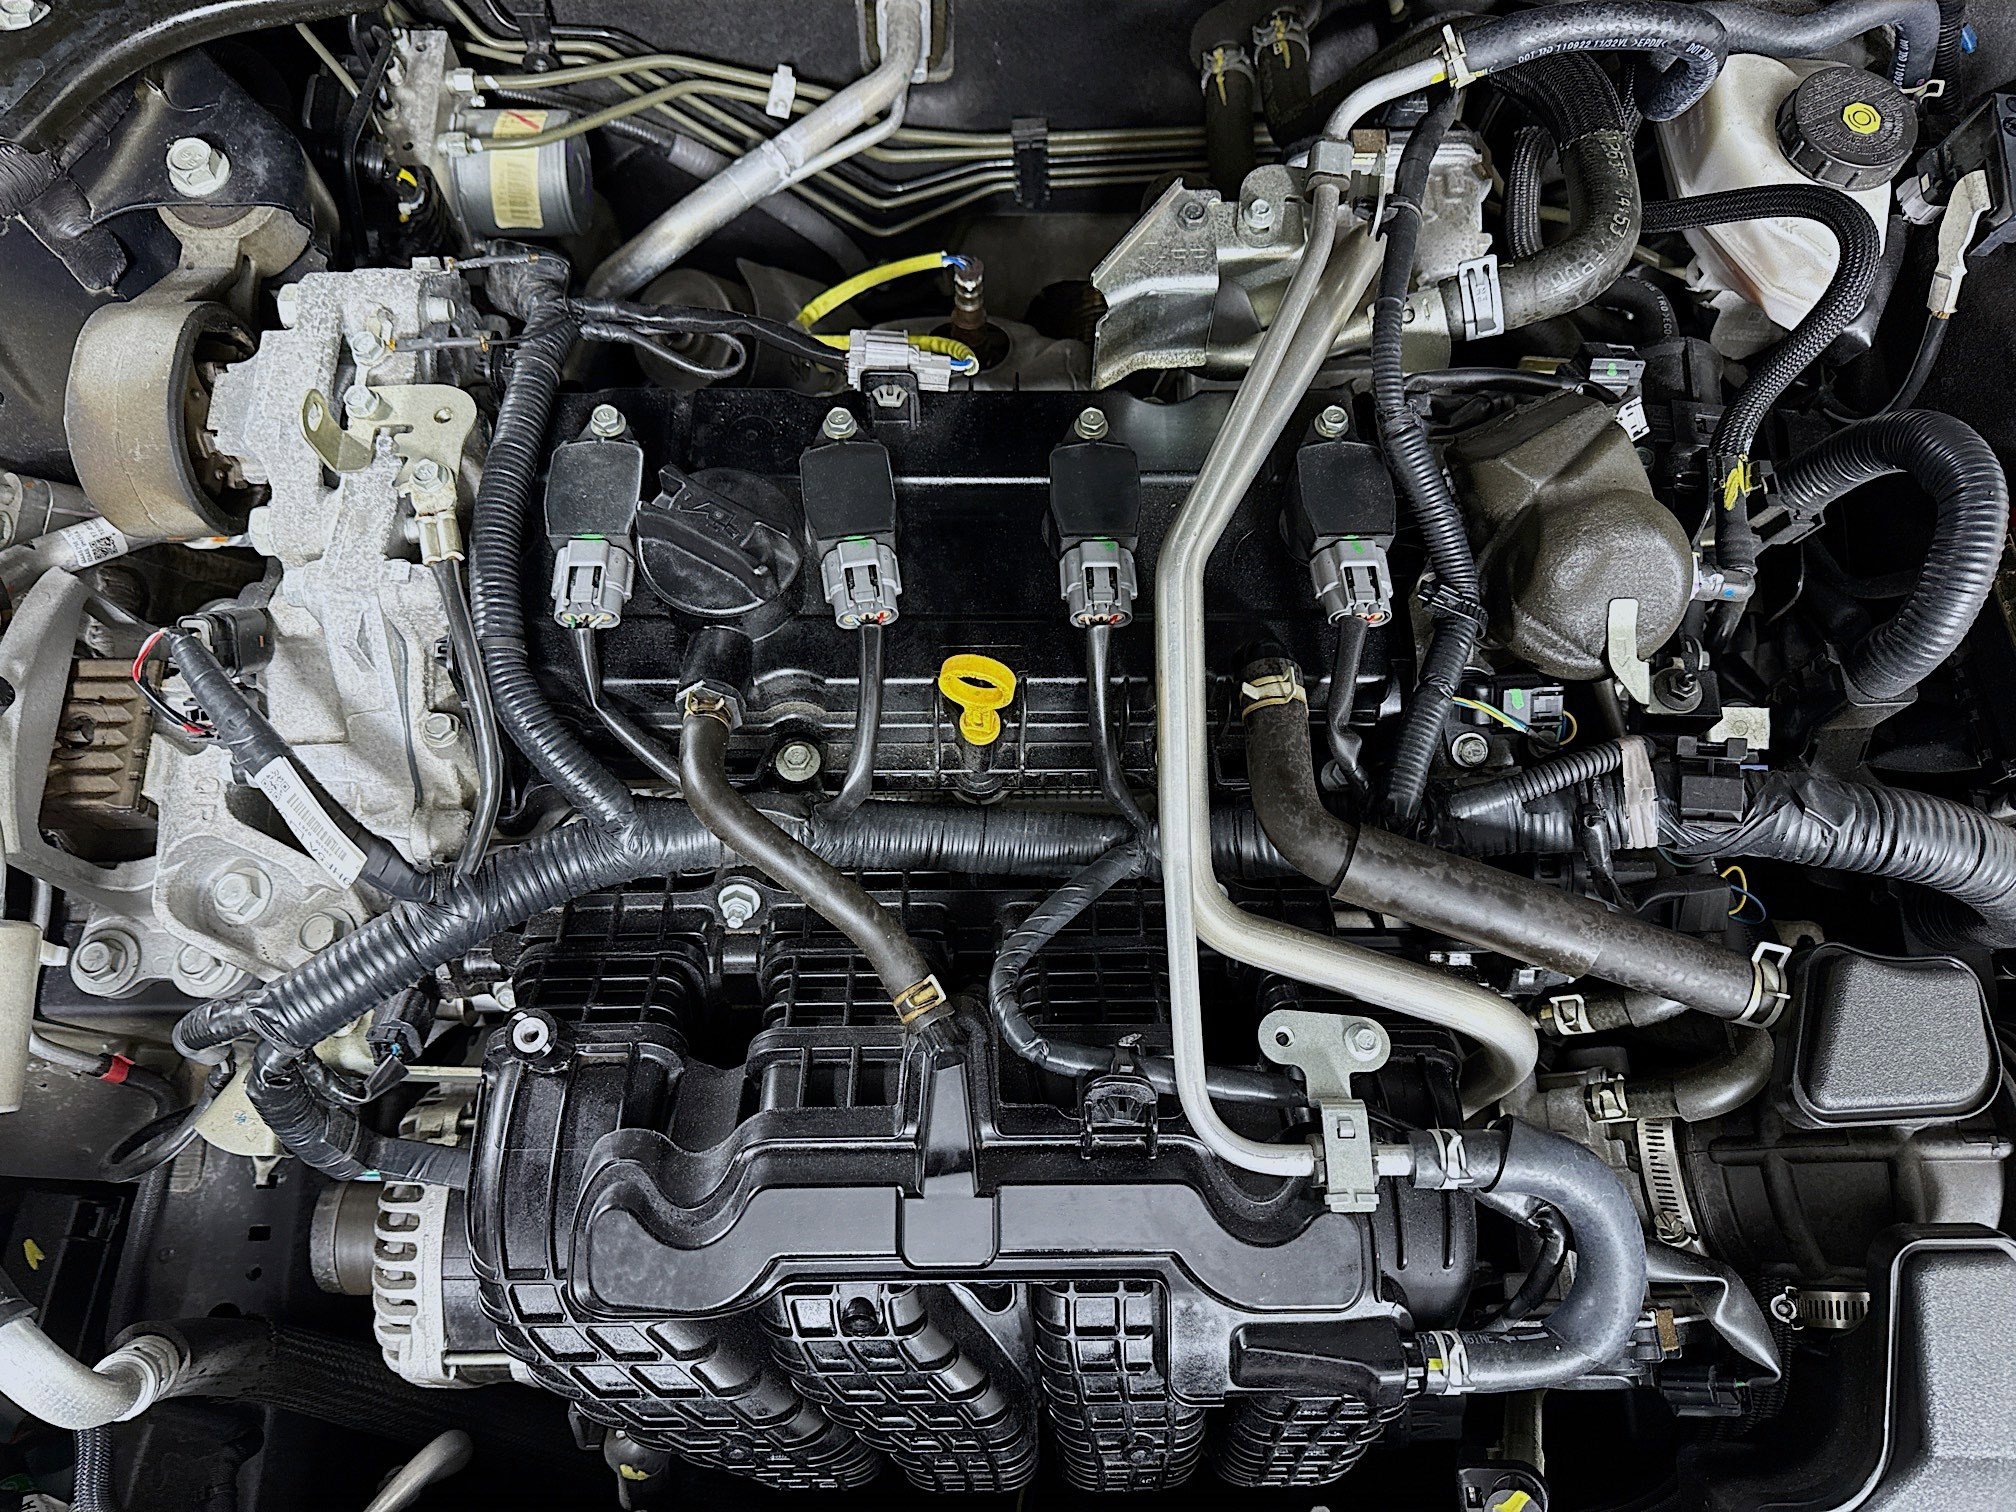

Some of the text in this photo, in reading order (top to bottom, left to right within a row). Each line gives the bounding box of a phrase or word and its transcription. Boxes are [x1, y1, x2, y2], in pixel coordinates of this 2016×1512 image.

[1518, 53, 1535, 64] DOT
[1556, 40, 1592, 53] 110922
[1685, 42, 1706, 56] DOT
